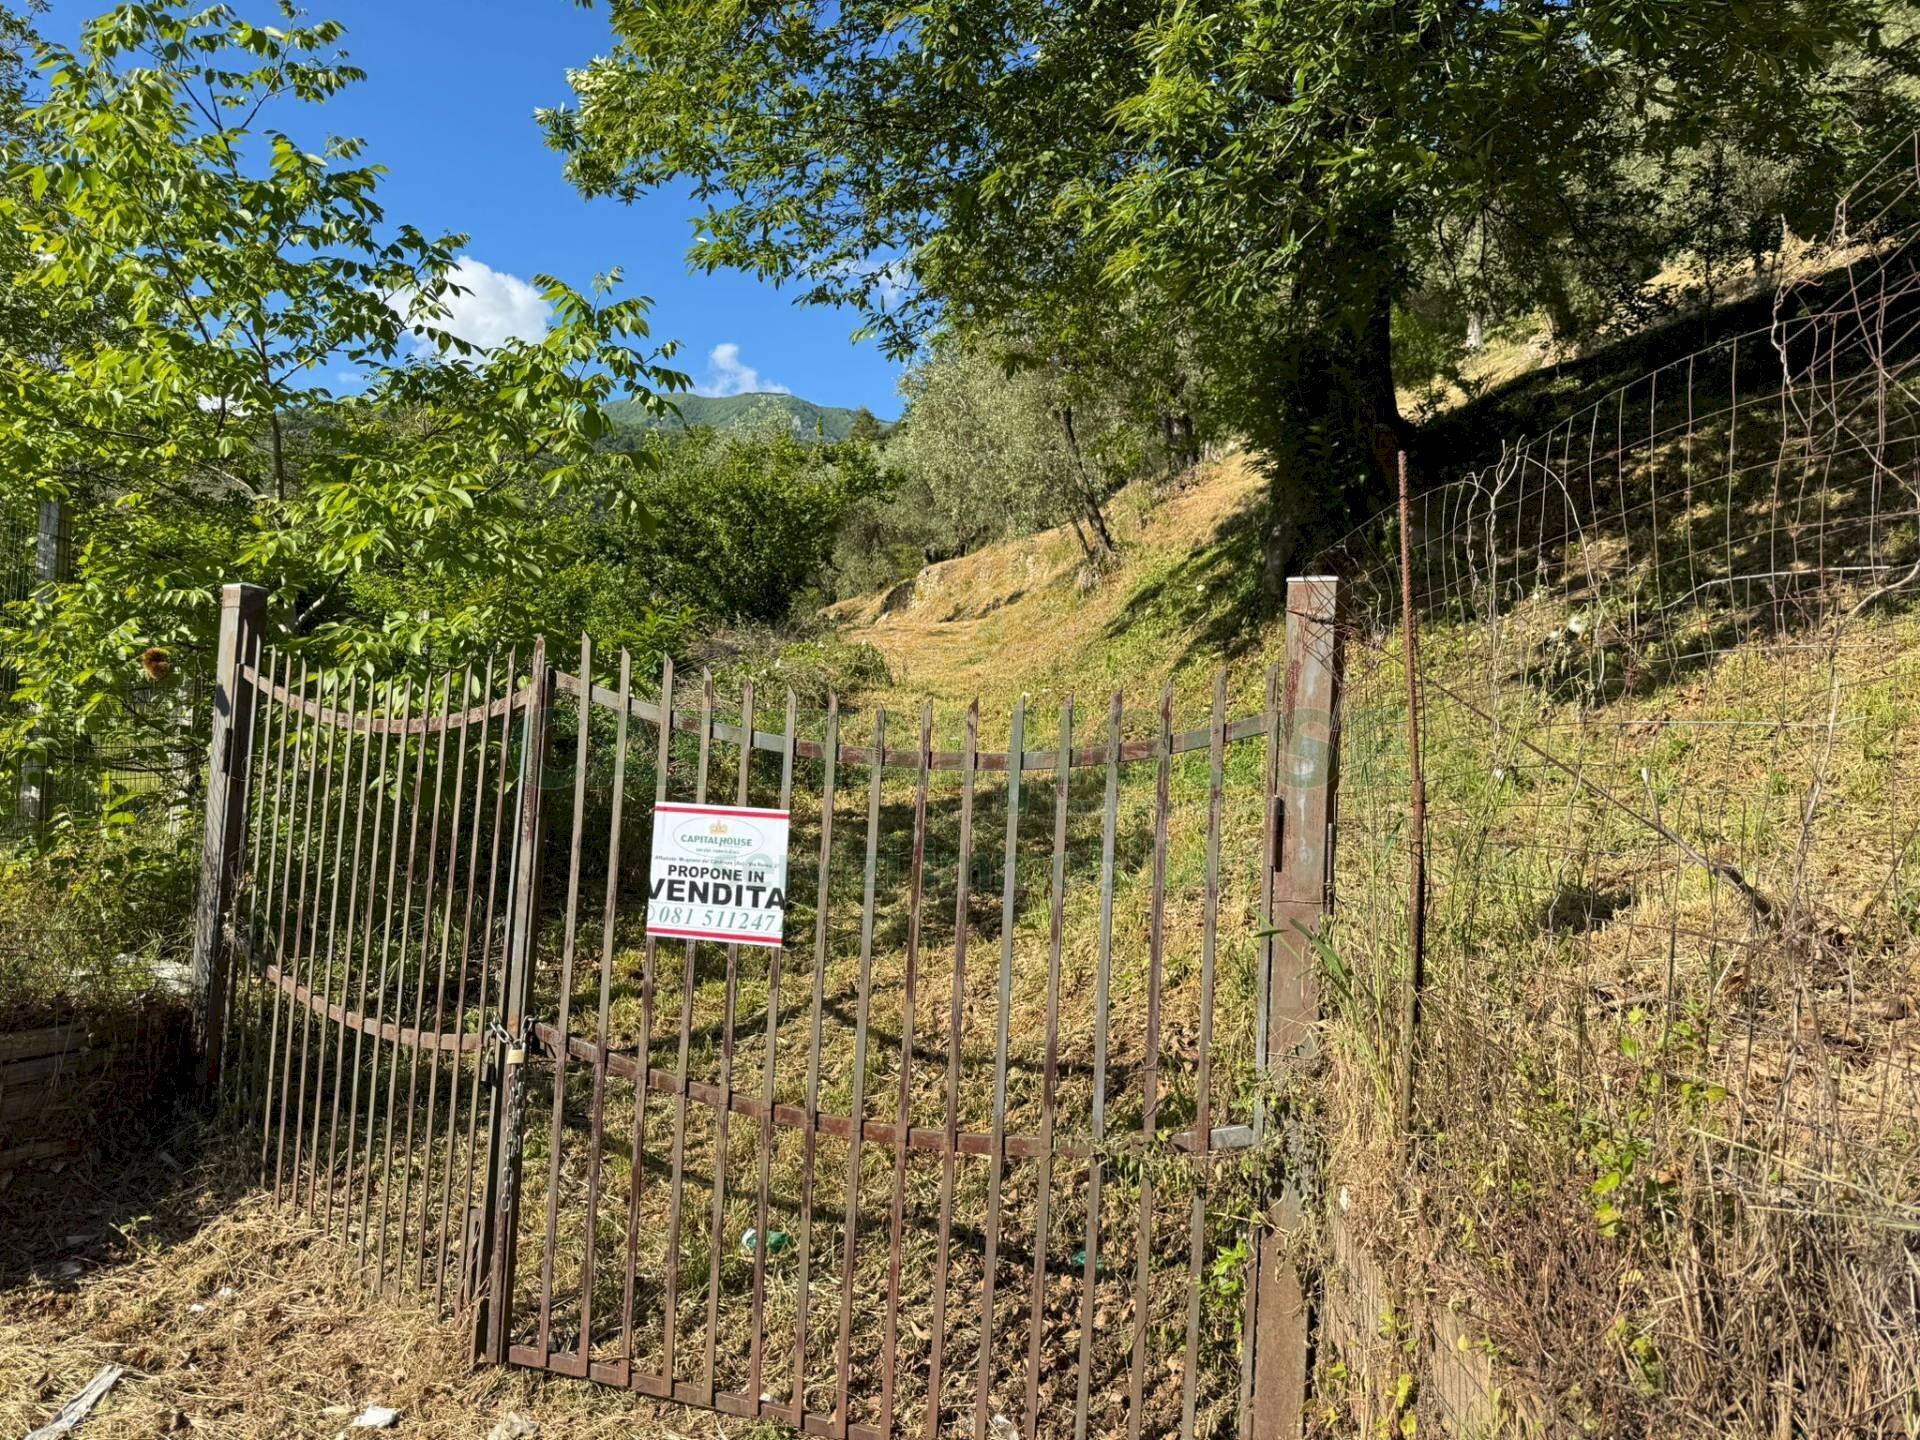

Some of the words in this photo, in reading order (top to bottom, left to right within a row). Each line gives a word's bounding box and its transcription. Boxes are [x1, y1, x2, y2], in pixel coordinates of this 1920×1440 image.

[668, 864, 742, 881] PROPONE
[748, 870, 765, 883] IN
[649, 878, 785, 910] VENDITA
[659, 905, 693, 924] 081
[702, 909, 782, 932] 511247
